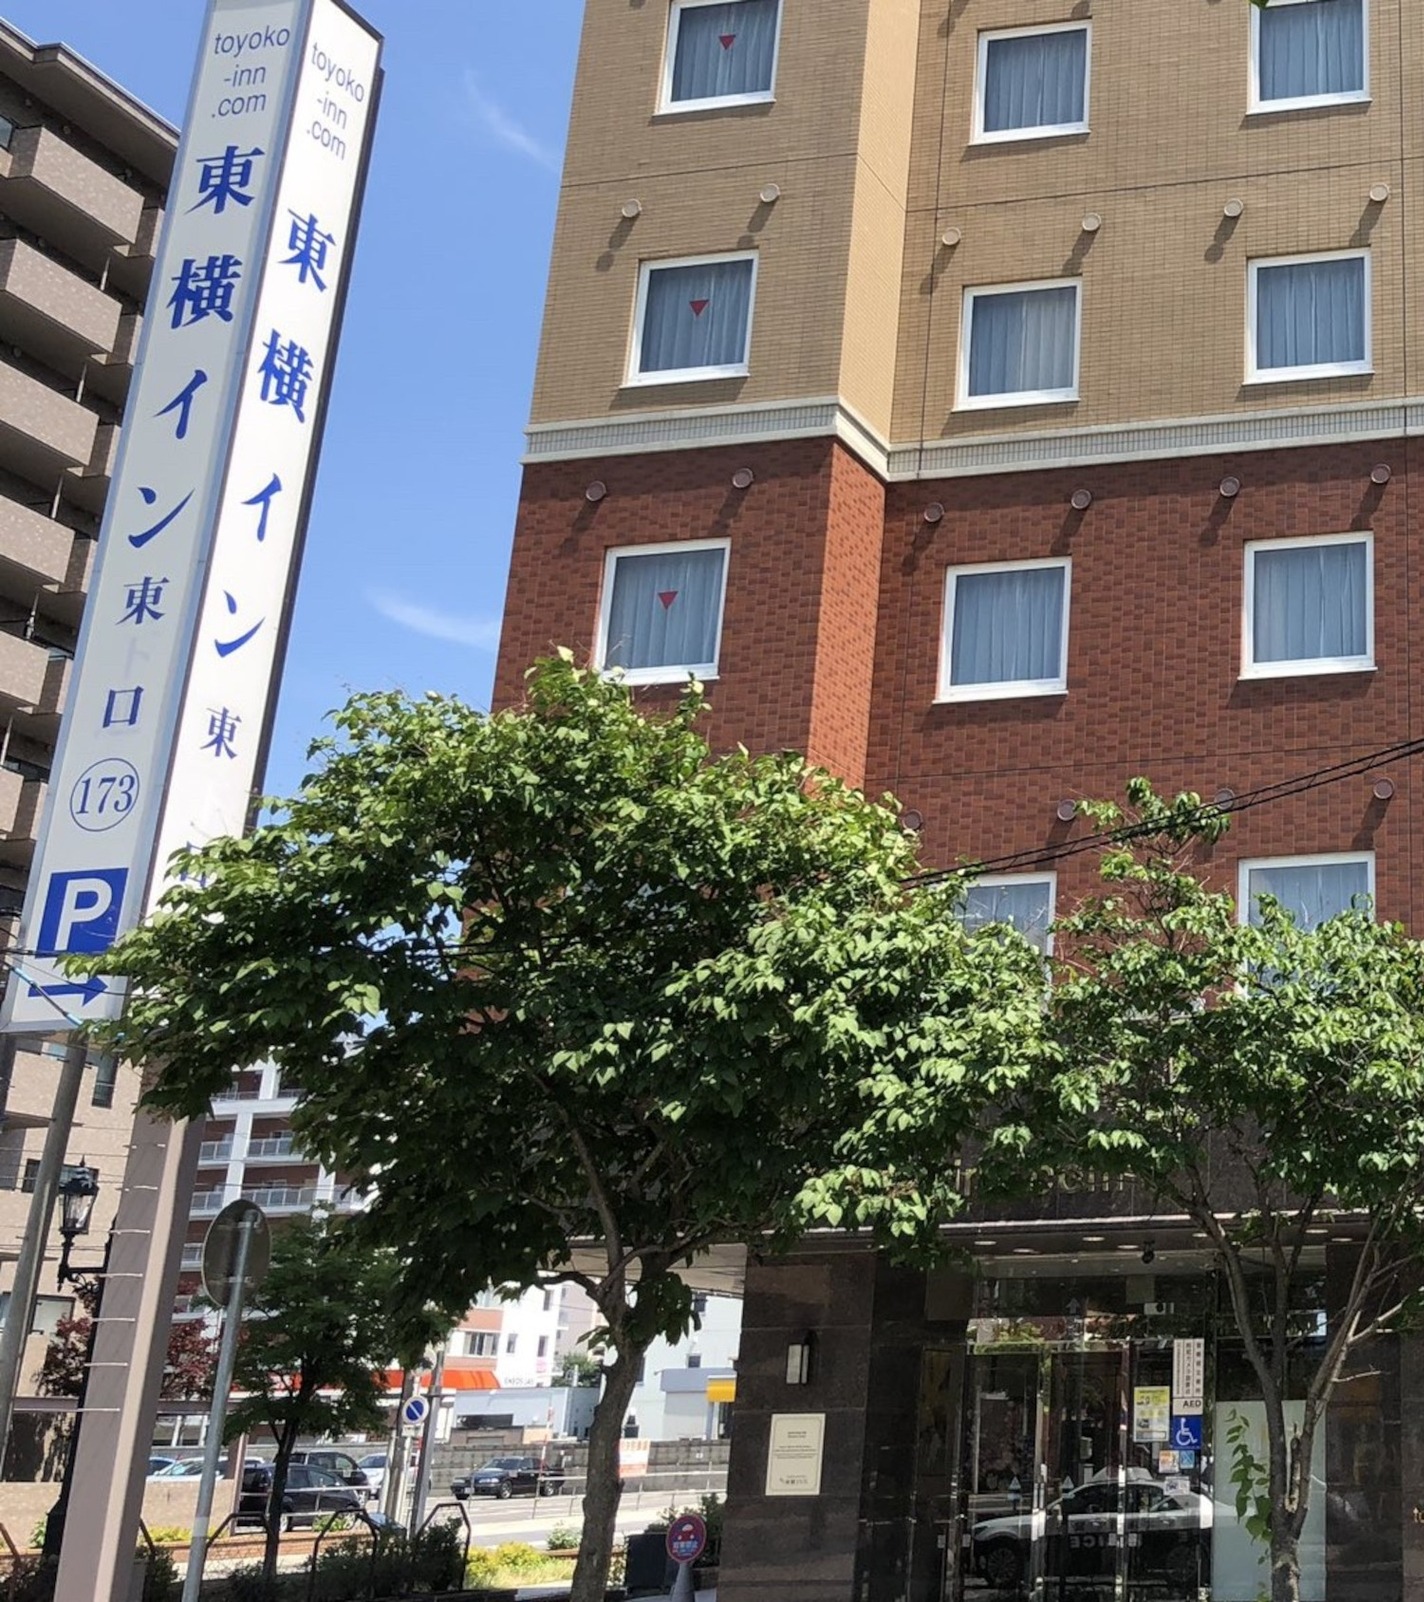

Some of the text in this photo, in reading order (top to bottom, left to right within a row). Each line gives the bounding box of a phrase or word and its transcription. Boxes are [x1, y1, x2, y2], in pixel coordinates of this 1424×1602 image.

[214, 26, 290, 57] toyoko
[224, 64, 266, 87] -inn
[311, 42, 365, 103] toyoko
[211, 92, 266, 118] .com
[317, 91, 348, 129] -inn
[306, 121, 346, 160] .com
[75, 775, 134, 815] 173
[56, 878, 113, 951] P
[1182, 1400, 1202, 1408] AED
